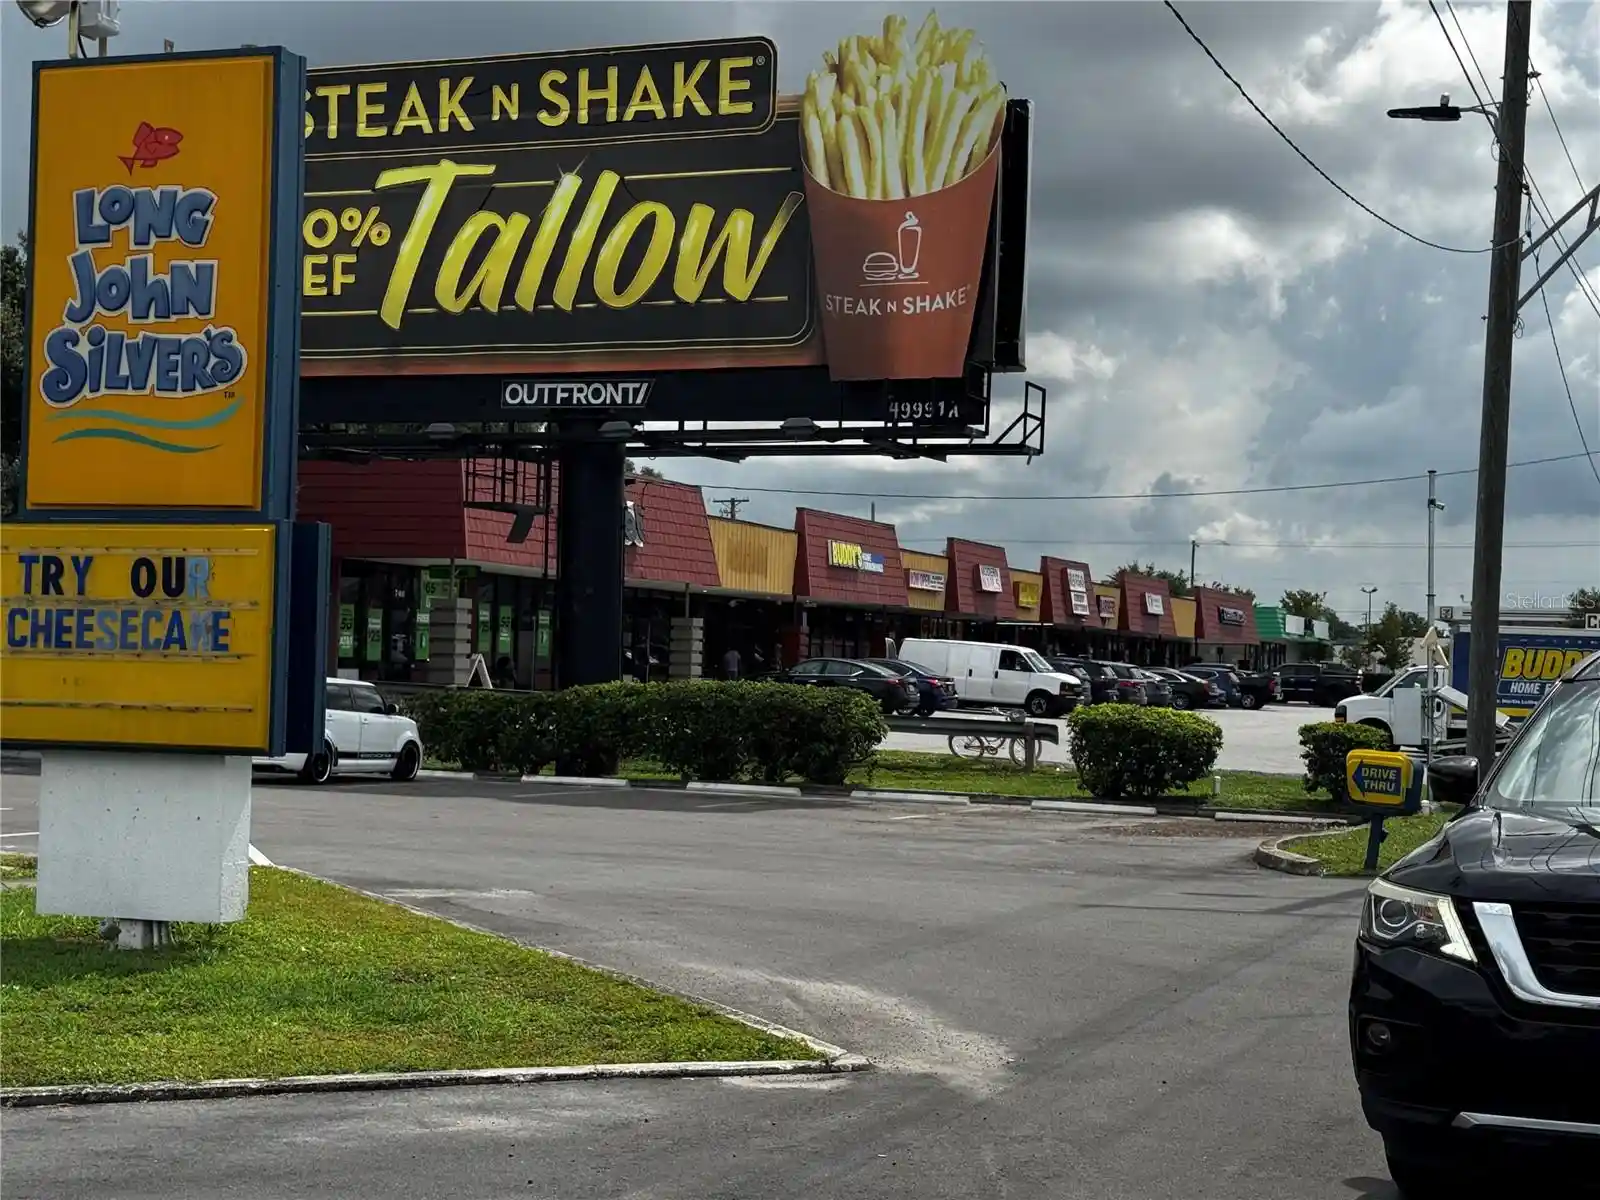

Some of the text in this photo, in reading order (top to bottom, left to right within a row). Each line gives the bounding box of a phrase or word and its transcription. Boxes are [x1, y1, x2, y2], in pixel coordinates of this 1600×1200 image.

[491, 83, 520, 121] N
[536, 56, 754, 127] SHAKE
[74, 185, 217, 249] LONG
[374, 158, 805, 330] Tallow
[826, 286, 968, 316] STEAK N SHAKE
[19, 555, 94, 595] TRY
[1510, 682, 1541, 694] HOME
[1362, 767, 1398, 780] DRIVE
[1363, 780, 1396, 791] THRU
